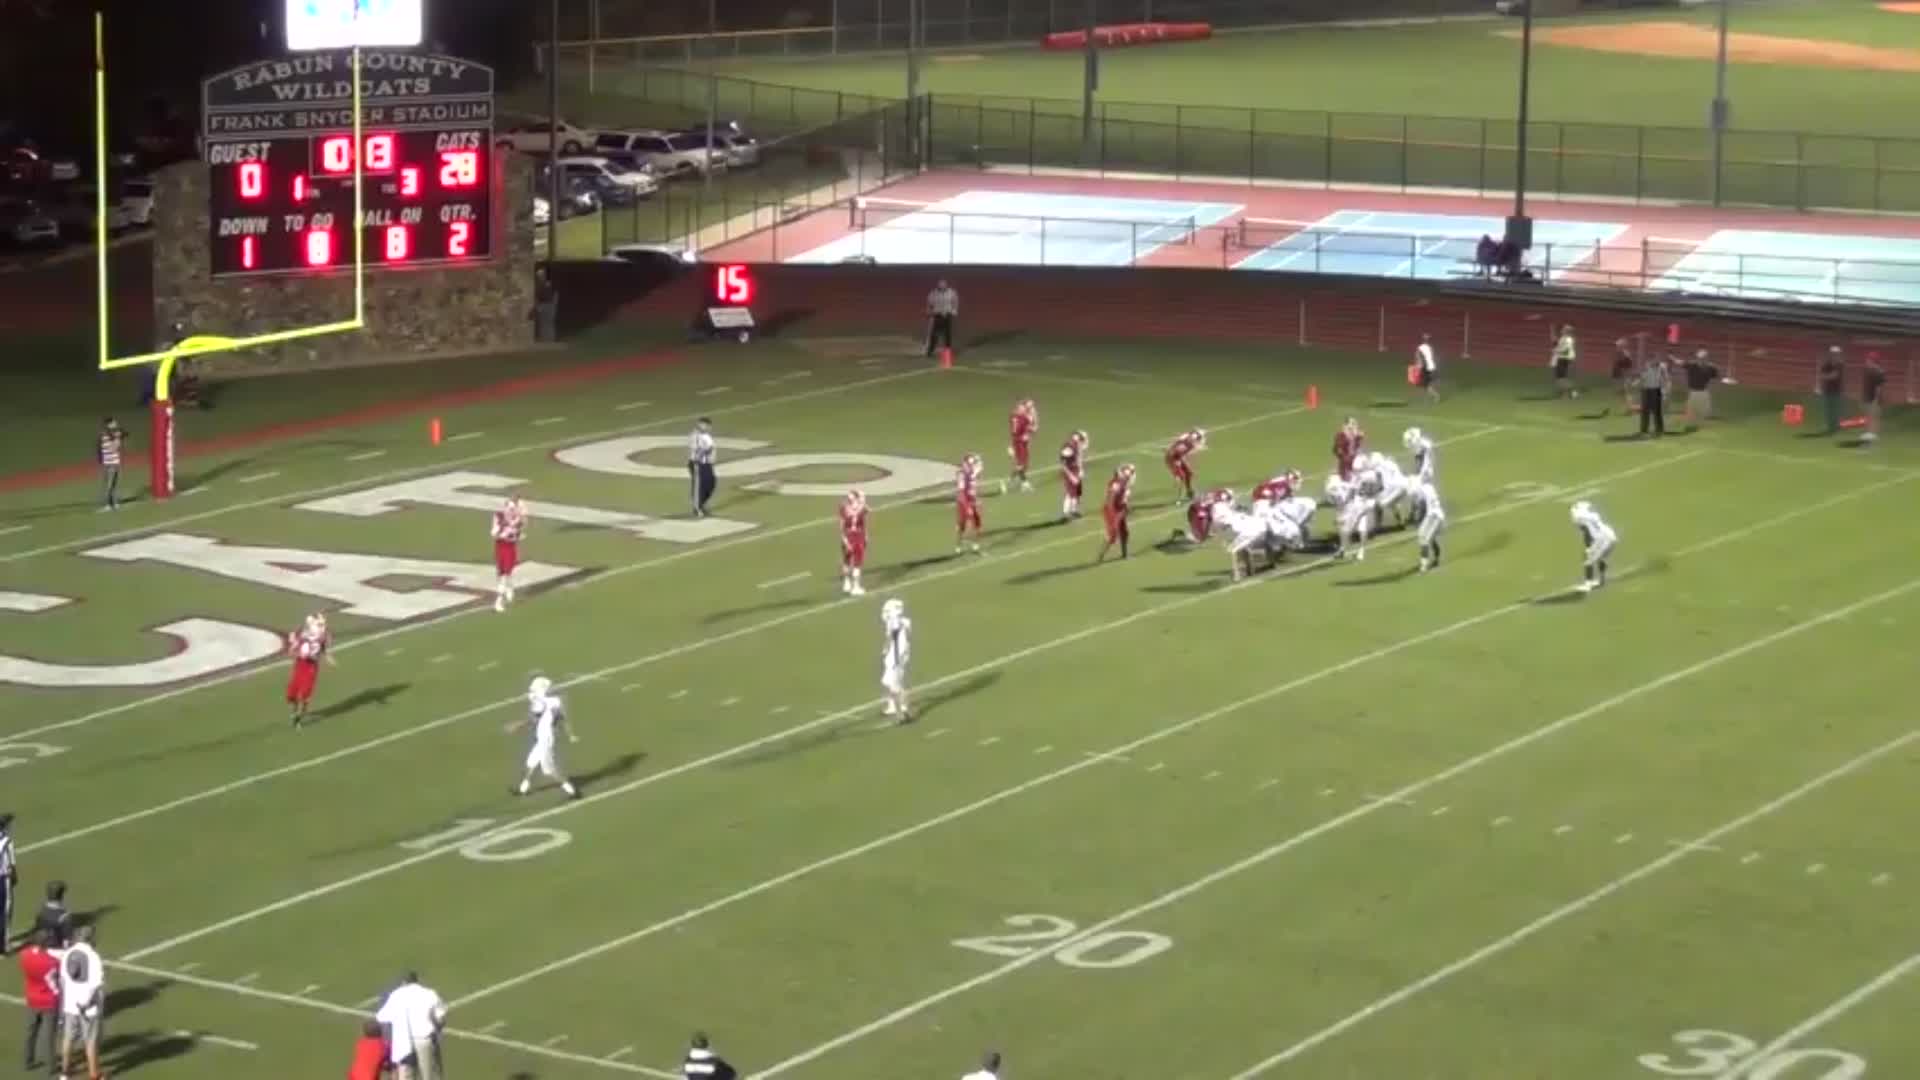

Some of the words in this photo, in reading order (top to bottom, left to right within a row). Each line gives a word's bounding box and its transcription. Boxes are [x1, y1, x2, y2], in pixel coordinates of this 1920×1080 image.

[232, 55, 332, 90] RABUN
[346, 53, 467, 79] COUNTY
[272, 76, 432, 100] WILDCATS
[210, 114, 285, 130] FRANK
[295, 108, 384, 128] SNYDER
[393, 103, 488, 123] STADIUM
[211, 142, 271, 164] GUEST
[435, 131, 480, 151] CATS
[240, 163, 262, 197] 0
[401, 168, 418, 195] 3
[440, 152, 476, 186] 28
[294, 175, 304, 201] 1
[218, 217, 269, 236] DOWN
[284, 215, 305, 232] TO
[311, 213, 334, 230] GO
[401, 207, 422, 224] ON
[243, 236, 253, 269] 1
[386, 226, 408, 260] 8
[449, 222, 468, 256] 2
[717, 264, 749, 303] 15
[396, 818, 573, 862] 10
[952, 913, 1174, 969] 20
[1637, 1028, 1867, 1080] 30
